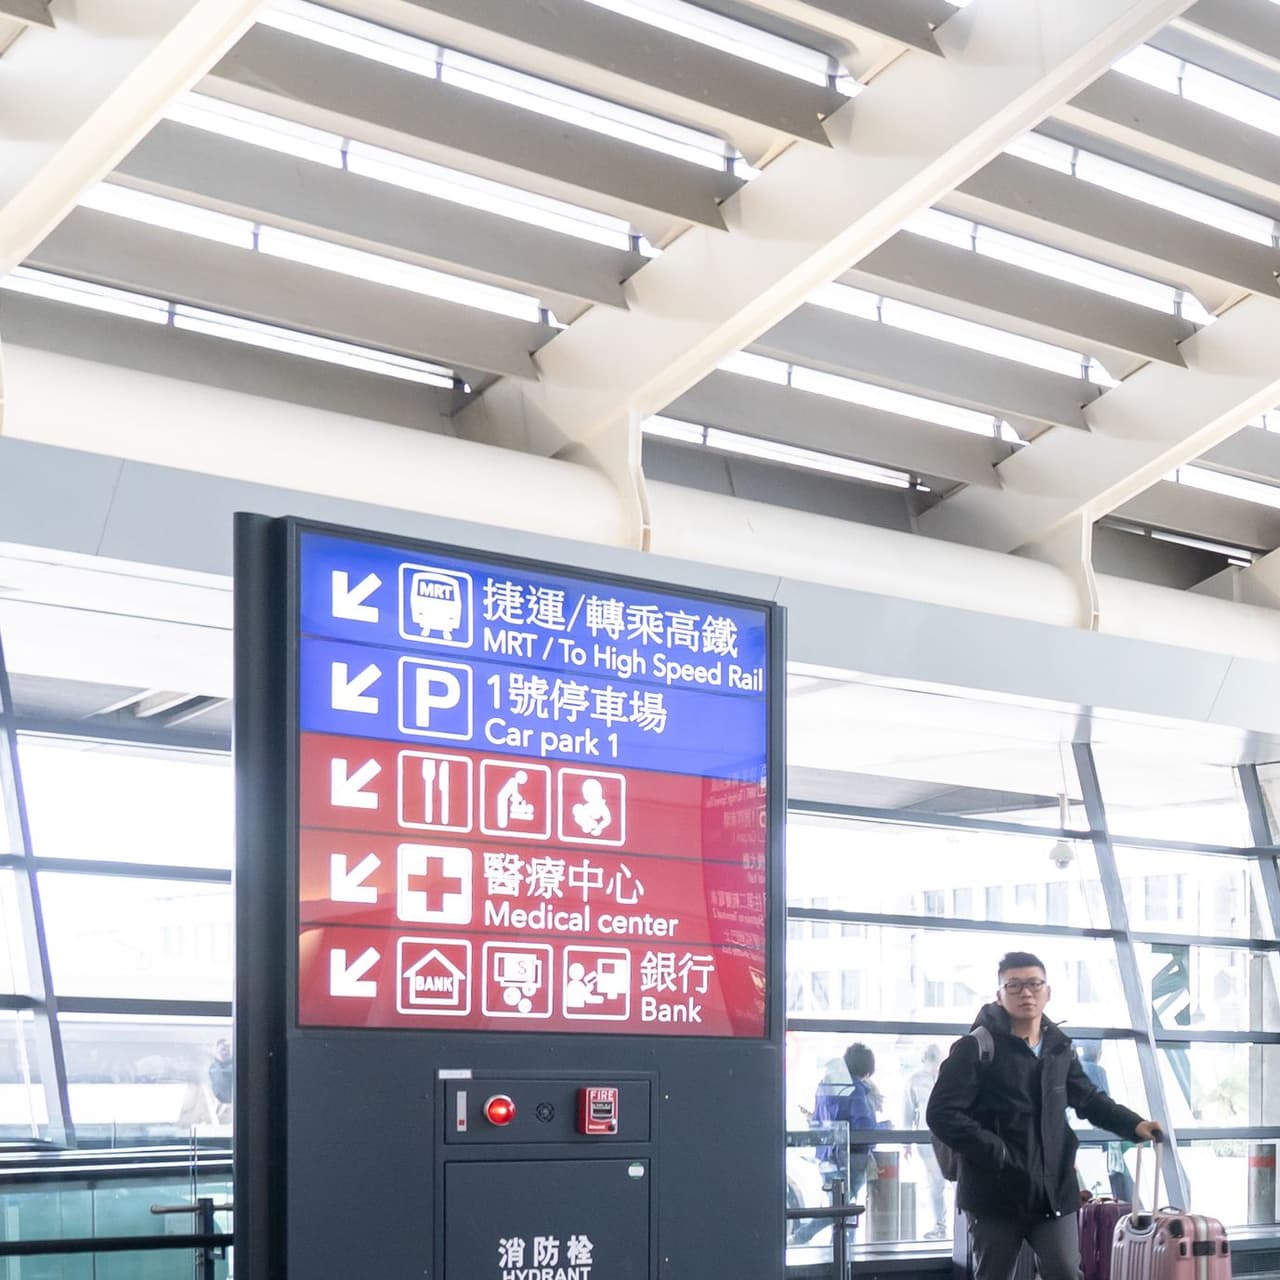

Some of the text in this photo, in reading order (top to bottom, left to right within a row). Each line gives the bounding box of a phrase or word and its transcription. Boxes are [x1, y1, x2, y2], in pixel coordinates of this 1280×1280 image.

[419, 582, 453, 599] MRT
[483, 578, 739, 658] 捷運/轉乘高鐵
[484, 627, 538, 657] MRT
[558, 639, 586, 665] To
[594, 637, 647, 678] High
[653, 653, 721, 685] Speed
[729, 665, 762, 691] Rail
[487, 673, 667, 734] 1號停車場
[485, 718, 617, 757] Car park 1
[483, 853, 644, 905] 醫療中心
[485, 901, 678, 936] Medical center
[415, 976, 453, 993] BANK
[641, 951, 714, 993] 銀行
[642, 997, 701, 1022] Bank
[590, 1090, 614, 1101] FIRE
[499, 1235, 593, 1267] 消防栓
